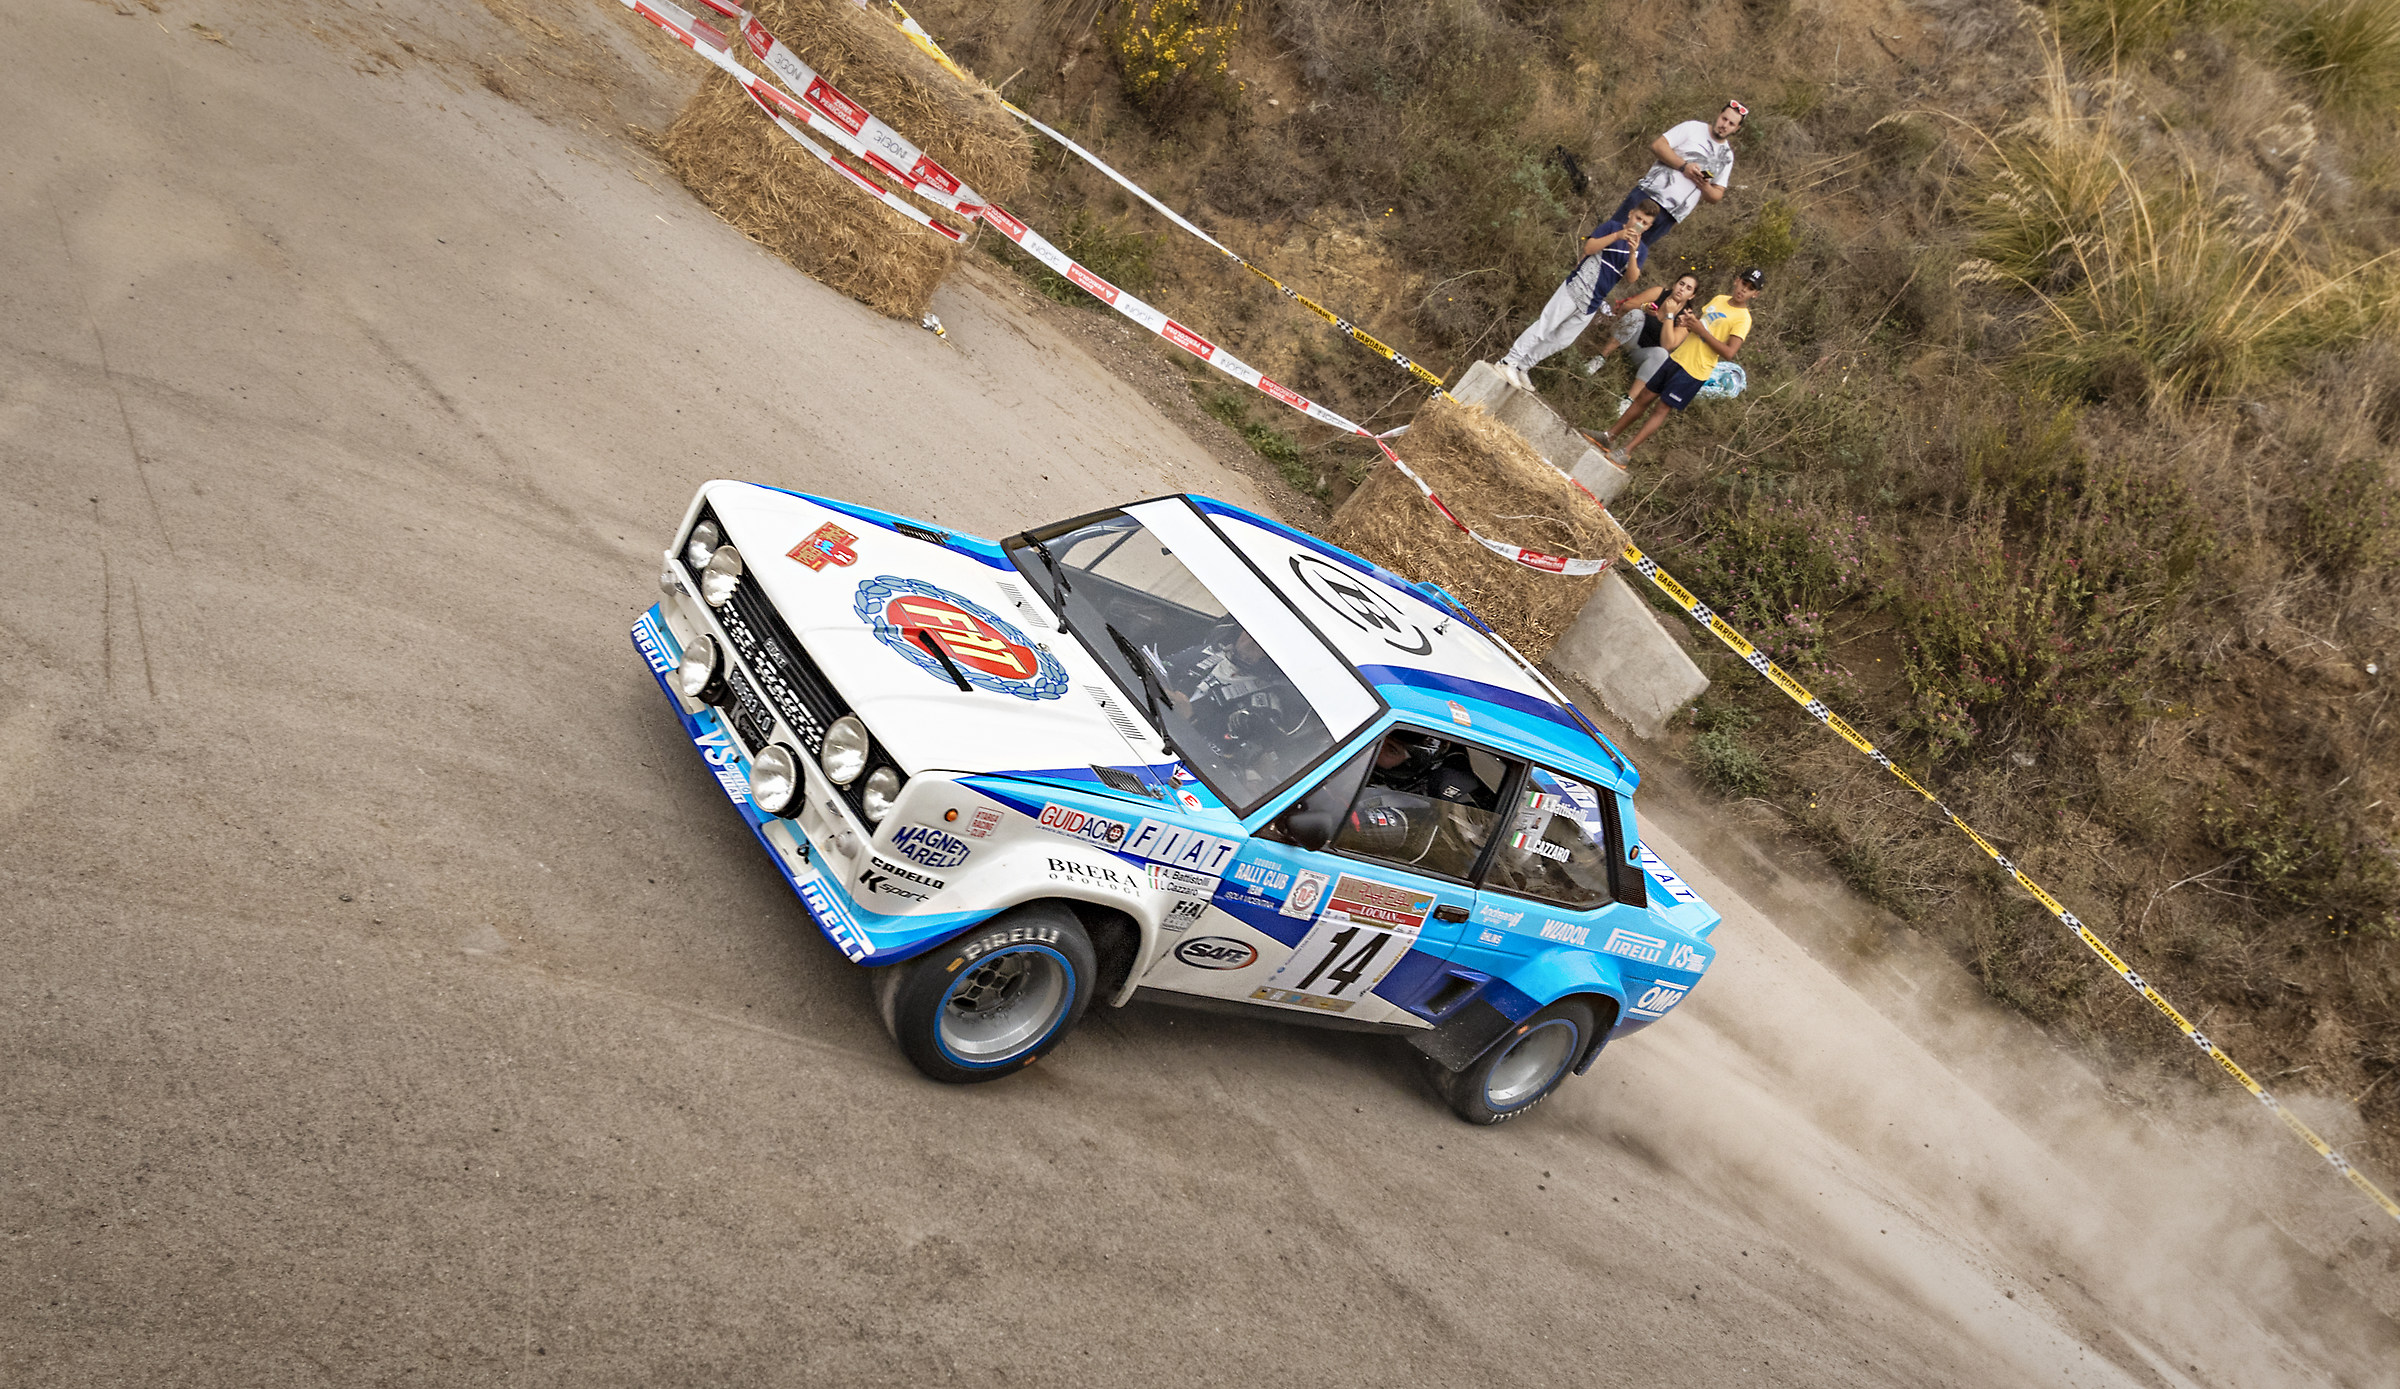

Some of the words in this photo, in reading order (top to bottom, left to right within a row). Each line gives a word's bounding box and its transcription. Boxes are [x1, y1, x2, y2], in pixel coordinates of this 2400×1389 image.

[661, 23, 681, 40] ZONA
[777, 100, 797, 116] ZONA
[819, 97, 860, 130] PERICOLOSA
[833, 99, 853, 115] ZONA
[887, 170, 904, 185] ZONA
[935, 173, 950, 188] ZONA
[986, 212, 1001, 224] ZONA
[1071, 267, 1106, 292] PERICOLOSA
[1078, 277, 1094, 290] ZONA
[1300, 298, 1332, 321] BARDAHL
[1166, 324, 1202, 348] PERICOLOSA
[1173, 334, 1190, 347] ZONA
[1355, 331, 1388, 356] BARDAHL
[1262, 378, 1298, 400] PERICOLOSA
[1657, 573, 1690, 605] BARDAHL
[900, 602, 1028, 674] FIAT
[1713, 619, 1747, 652] BARDAHL
[1770, 667, 1806, 699] BARDAHL
[756, 709, 771, 731] CO
[1830, 716, 1866, 747] BARDAHL
[694, 728, 739, 767] VS
[718, 772, 744, 802] FIAT
[1133, 825, 1232, 868] FIAT
[871, 856, 945, 890] CARELLO
[1047, 858, 1139, 889] BRERA
[1172, 870, 1211, 887] Battistolli
[1234, 862, 1264, 886] RALLY
[1263, 868, 1290, 890] CLUB
[1639, 846, 1694, 899] IAT
[1050, 873, 1140, 898] OROLOGI
[793, 868, 876, 964] PIRELLI
[1171, 900, 1202, 918] FIA
[1360, 906, 1398, 921] LOCMAN
[962, 927, 1060, 961] PIRELLI
[1183, 943, 1250, 964] SAFE
[1603, 927, 1667, 963] PIRELLI
[1668, 942, 1693, 968] VS
[1295, 927, 1393, 996] 14
[1638, 986, 1682, 1012] OMP
